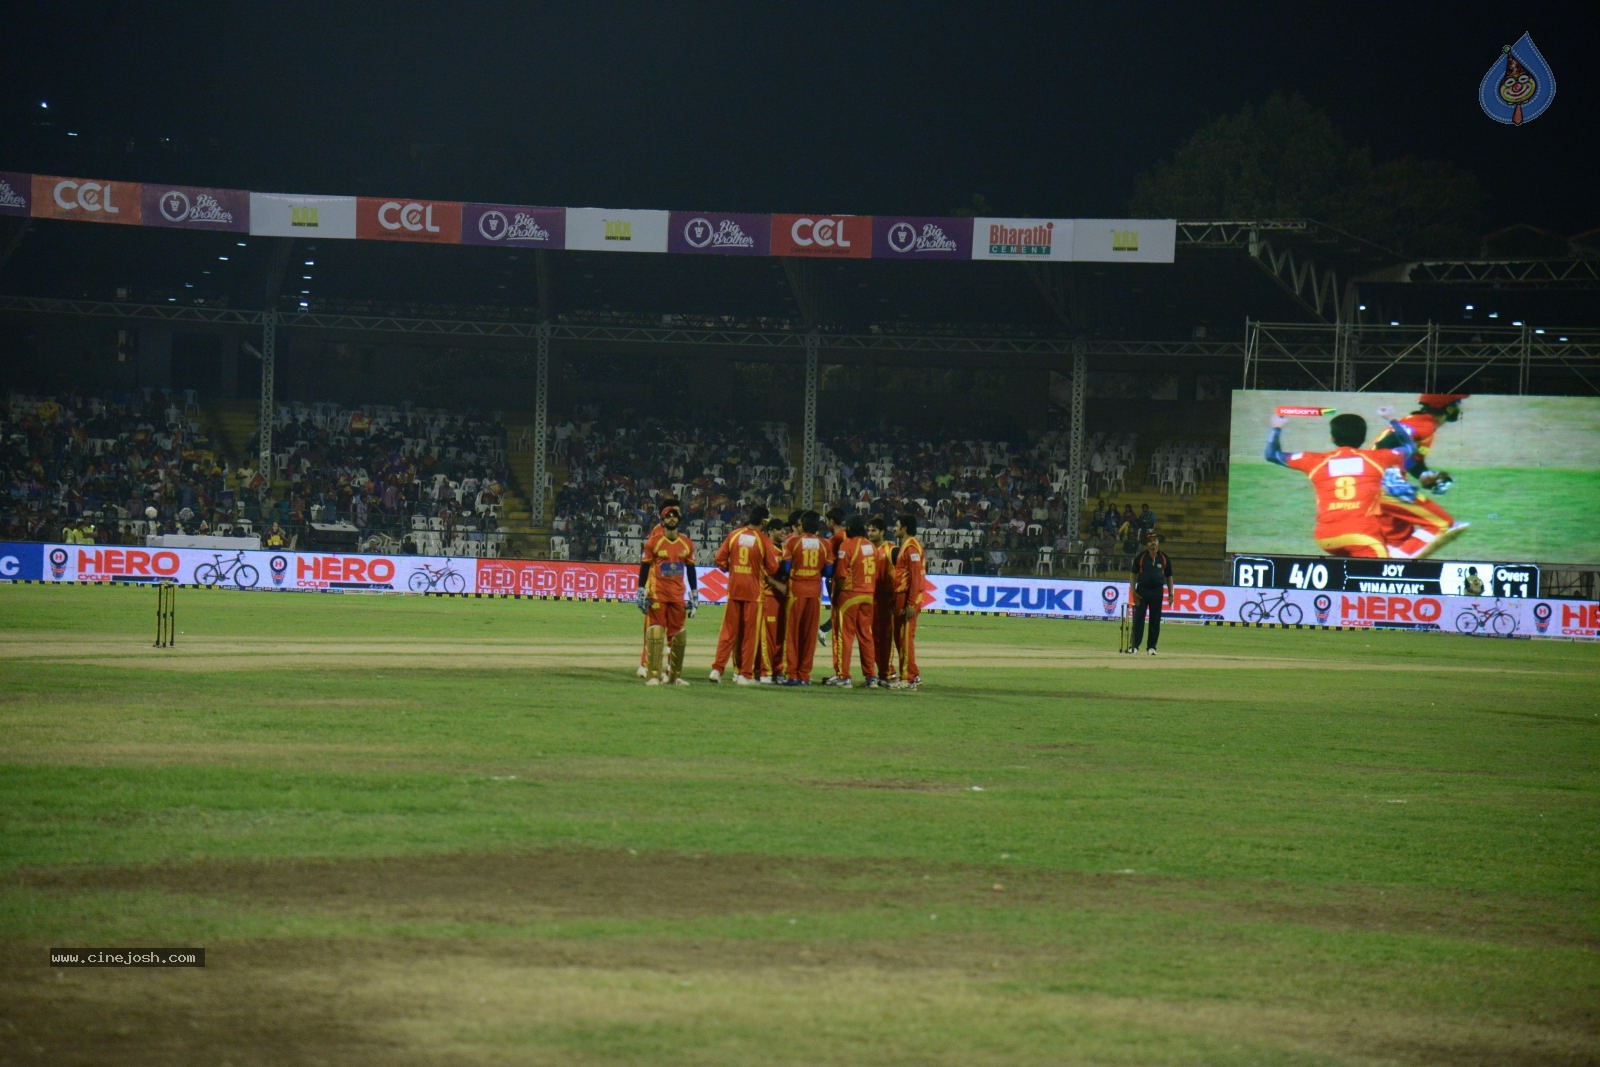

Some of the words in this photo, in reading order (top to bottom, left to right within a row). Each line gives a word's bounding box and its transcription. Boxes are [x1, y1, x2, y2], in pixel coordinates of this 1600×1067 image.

[53, 181, 119, 213] CCL
[196, 194, 219, 211] Big
[189, 207, 233, 221] Brother
[378, 202, 440, 232] CCL
[514, 212, 536, 229] Big
[507, 224, 551, 239] Brother
[719, 219, 742, 236] Big
[791, 218, 850, 247] CCL
[922, 223, 944, 240] Big
[712, 231, 755, 245] Brother
[915, 235, 958, 249] Brother
[990, 222, 1054, 253] Bharathi
[991, 246, 1048, 254] CEMENT
[77, 549, 180, 575] HERO
[738, 546, 749, 565] 9
[802, 549, 819, 567] 18
[296, 556, 395, 582] HERO
[862, 556, 876, 575] 15
[1381, 564, 1405, 577] JOY
[296, 580, 329, 588] CYCLES
[479, 568, 516, 589] RED
[520, 569, 557, 591] RED
[561, 571, 599, 593] RED
[602, 573, 640, 594] RED
[1239, 564, 1269, 588] BT
[1288, 562, 1328, 590] 4/0
[1496, 569, 1529, 582] Overs
[945, 584, 1083, 611] SUZUKI
[1502, 583, 1528, 598] 1.1
[1341, 595, 1442, 622] HERO
[1340, 619, 1373, 627] CYCLES
